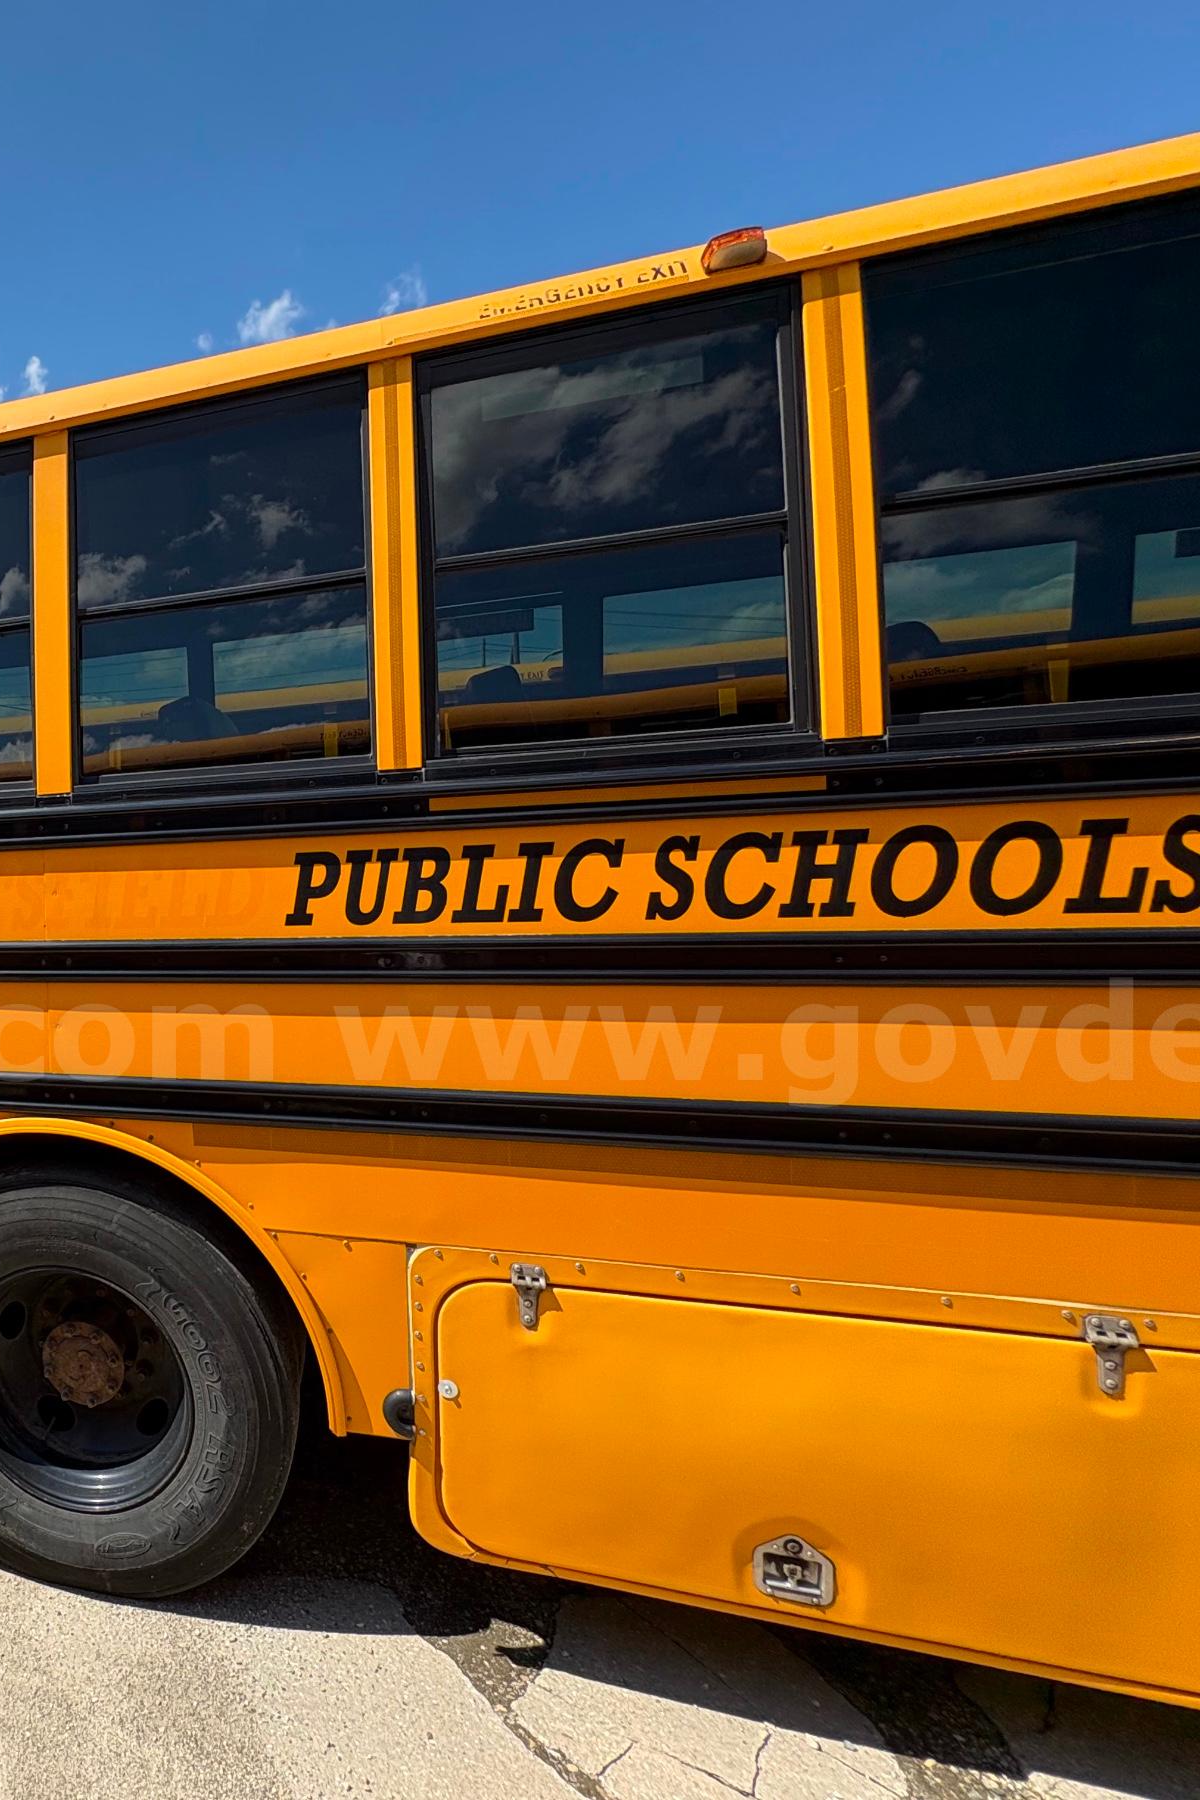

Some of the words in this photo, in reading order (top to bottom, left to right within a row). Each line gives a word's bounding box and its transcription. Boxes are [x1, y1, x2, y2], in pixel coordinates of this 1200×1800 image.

[284, 838, 626, 925] PUBLIC
[645, 815, 1200, 921] SCHOOLS
[175, 1433, 237, 1527] RSA
